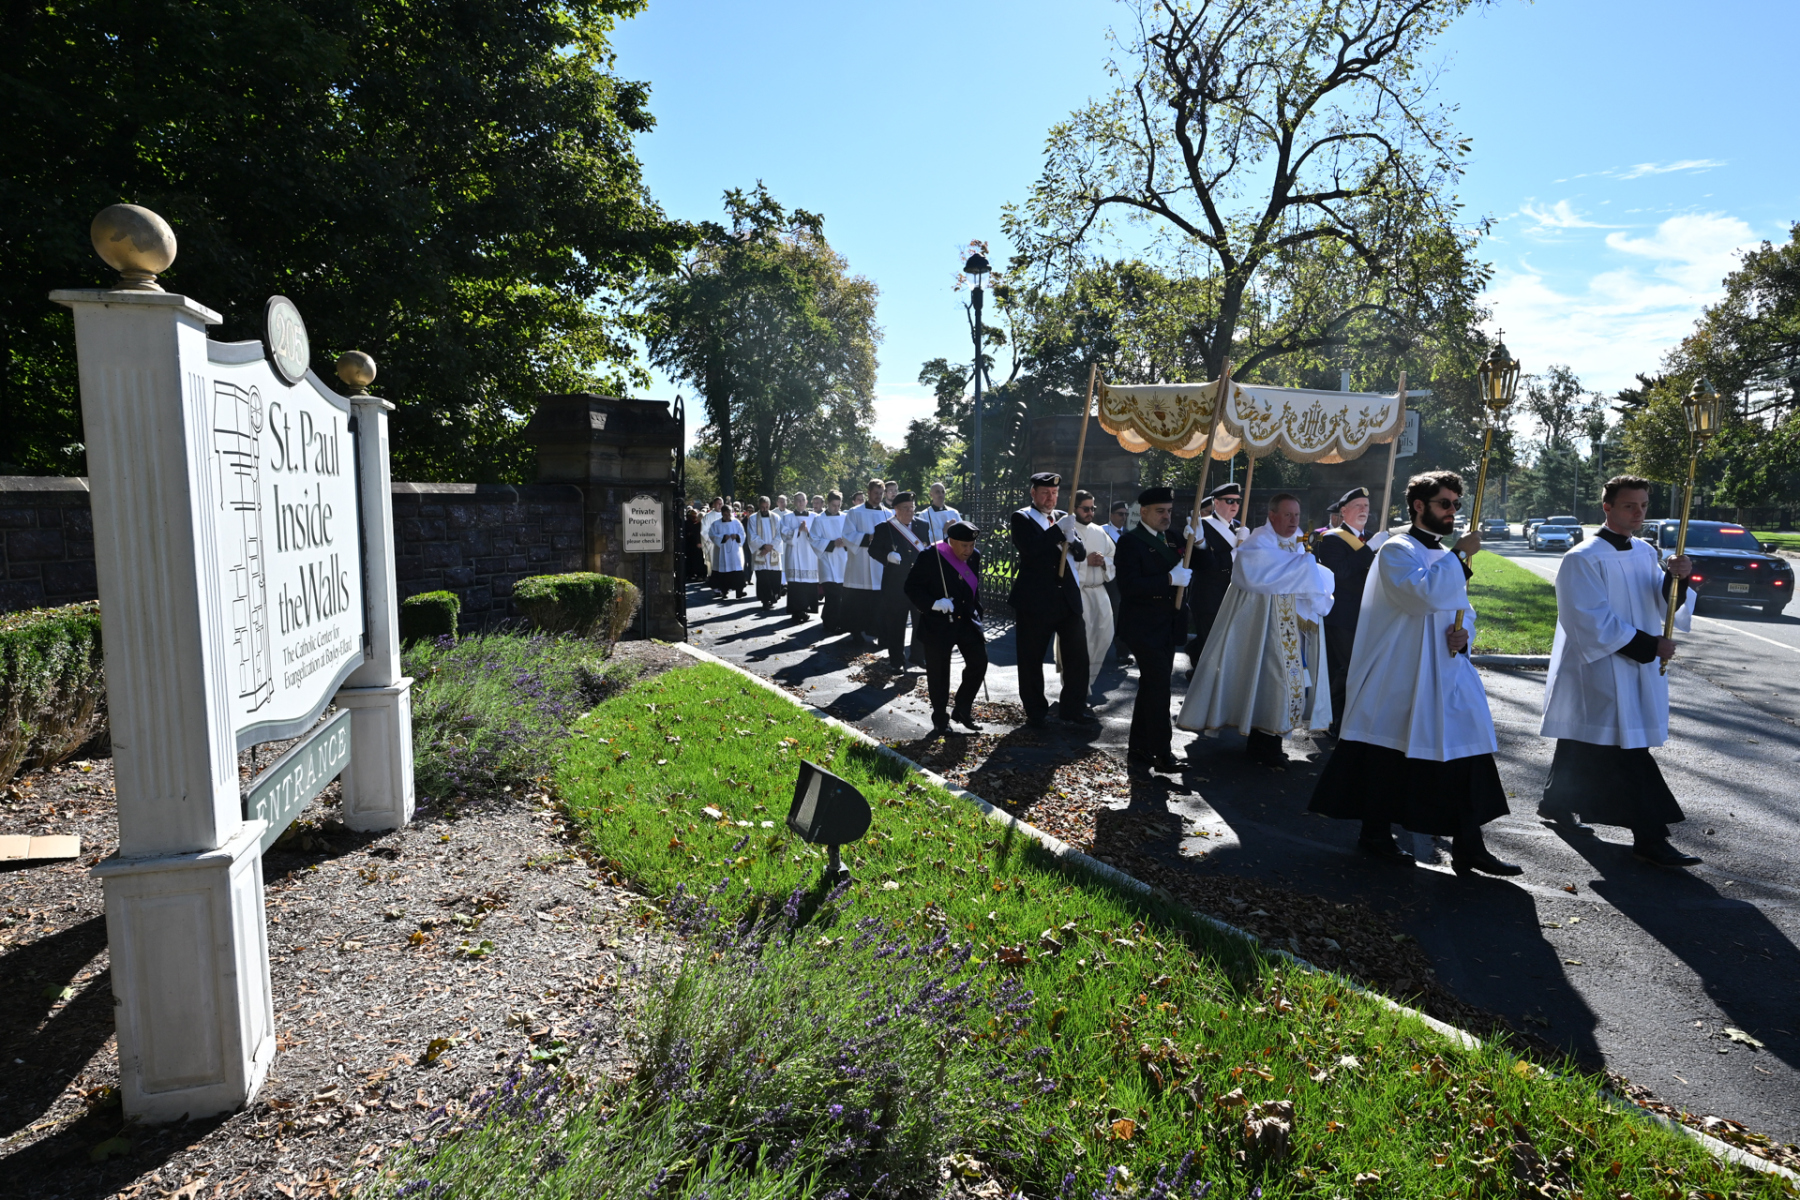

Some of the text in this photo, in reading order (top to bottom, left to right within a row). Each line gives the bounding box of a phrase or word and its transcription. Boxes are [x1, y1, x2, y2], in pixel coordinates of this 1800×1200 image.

[276, 313, 304, 366] 205
[269, 401, 340, 477] St. Paul
[273, 482, 334, 553] Inside
[628, 517, 658, 526] Property
[283, 646, 295, 666] The
[295, 634, 317, 659] Catholic
[317, 630, 333, 648] Center
[283, 657, 321, 690] Evangelization
[320, 652, 326, 668] at
[256, 726, 347, 832] ENTRANCE
